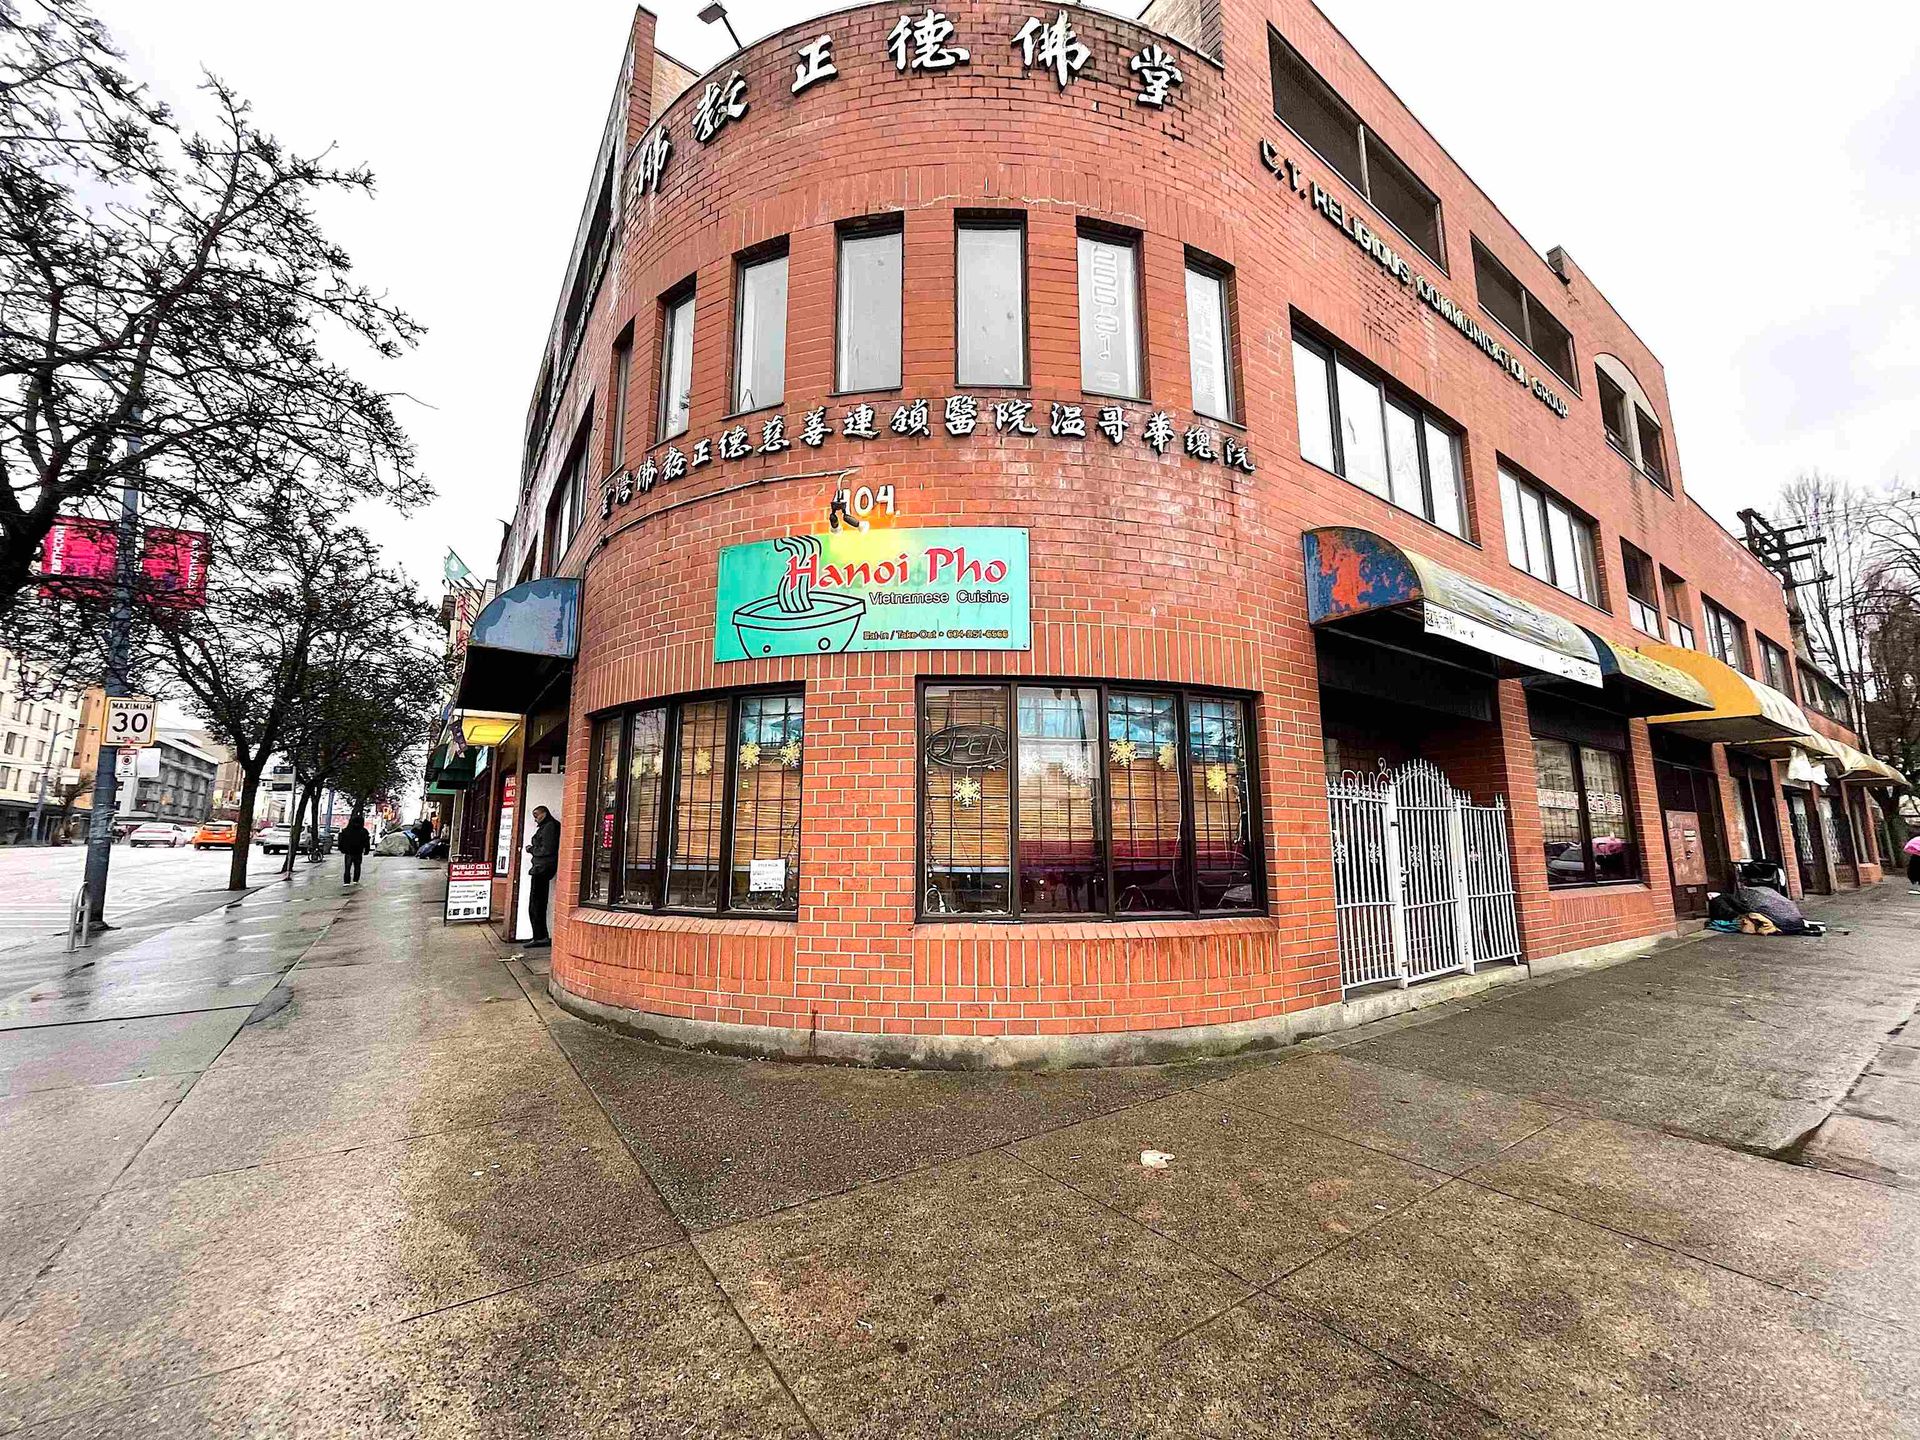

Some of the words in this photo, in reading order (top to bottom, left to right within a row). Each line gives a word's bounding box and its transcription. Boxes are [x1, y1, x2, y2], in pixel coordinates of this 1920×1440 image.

[1310, 178, 1411, 285] RELIGIOUS
[1416, 275, 1529, 388] COMMUNICATION
[1531, 376, 1569, 418] GROUP
[785, 552, 909, 591] Hanoi
[925, 546, 1008, 585] Pho
[869, 591, 950, 605] Vietnamese
[956, 590, 1009, 603] Cuisine
[112, 702, 152, 710] MAXIMUM
[112, 712, 148, 733] 30
[930, 733, 1008, 757] OPEN
